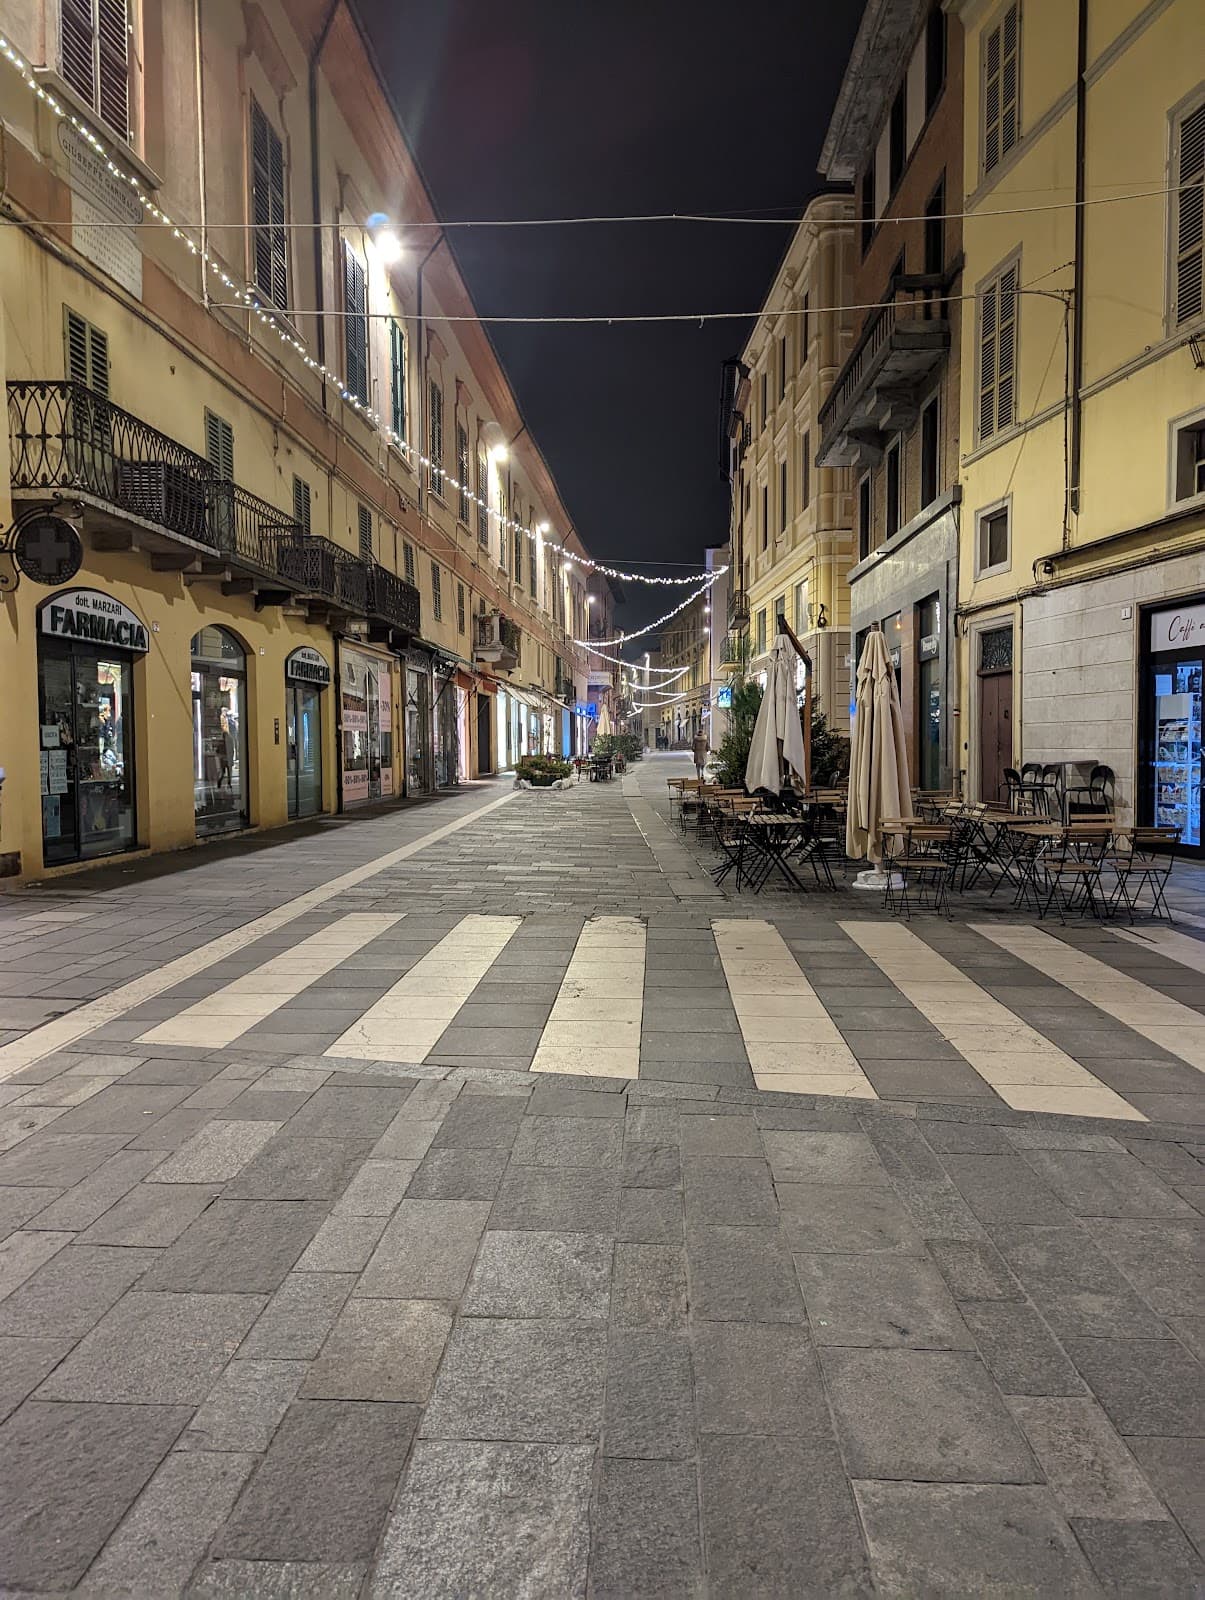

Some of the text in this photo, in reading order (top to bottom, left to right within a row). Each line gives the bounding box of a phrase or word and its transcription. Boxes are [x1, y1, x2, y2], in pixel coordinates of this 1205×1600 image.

[75, 594, 122, 616] dott. MARZARI
[50, 605, 147, 648] FARMACIA
[291, 659, 330, 682] FARMACIA
